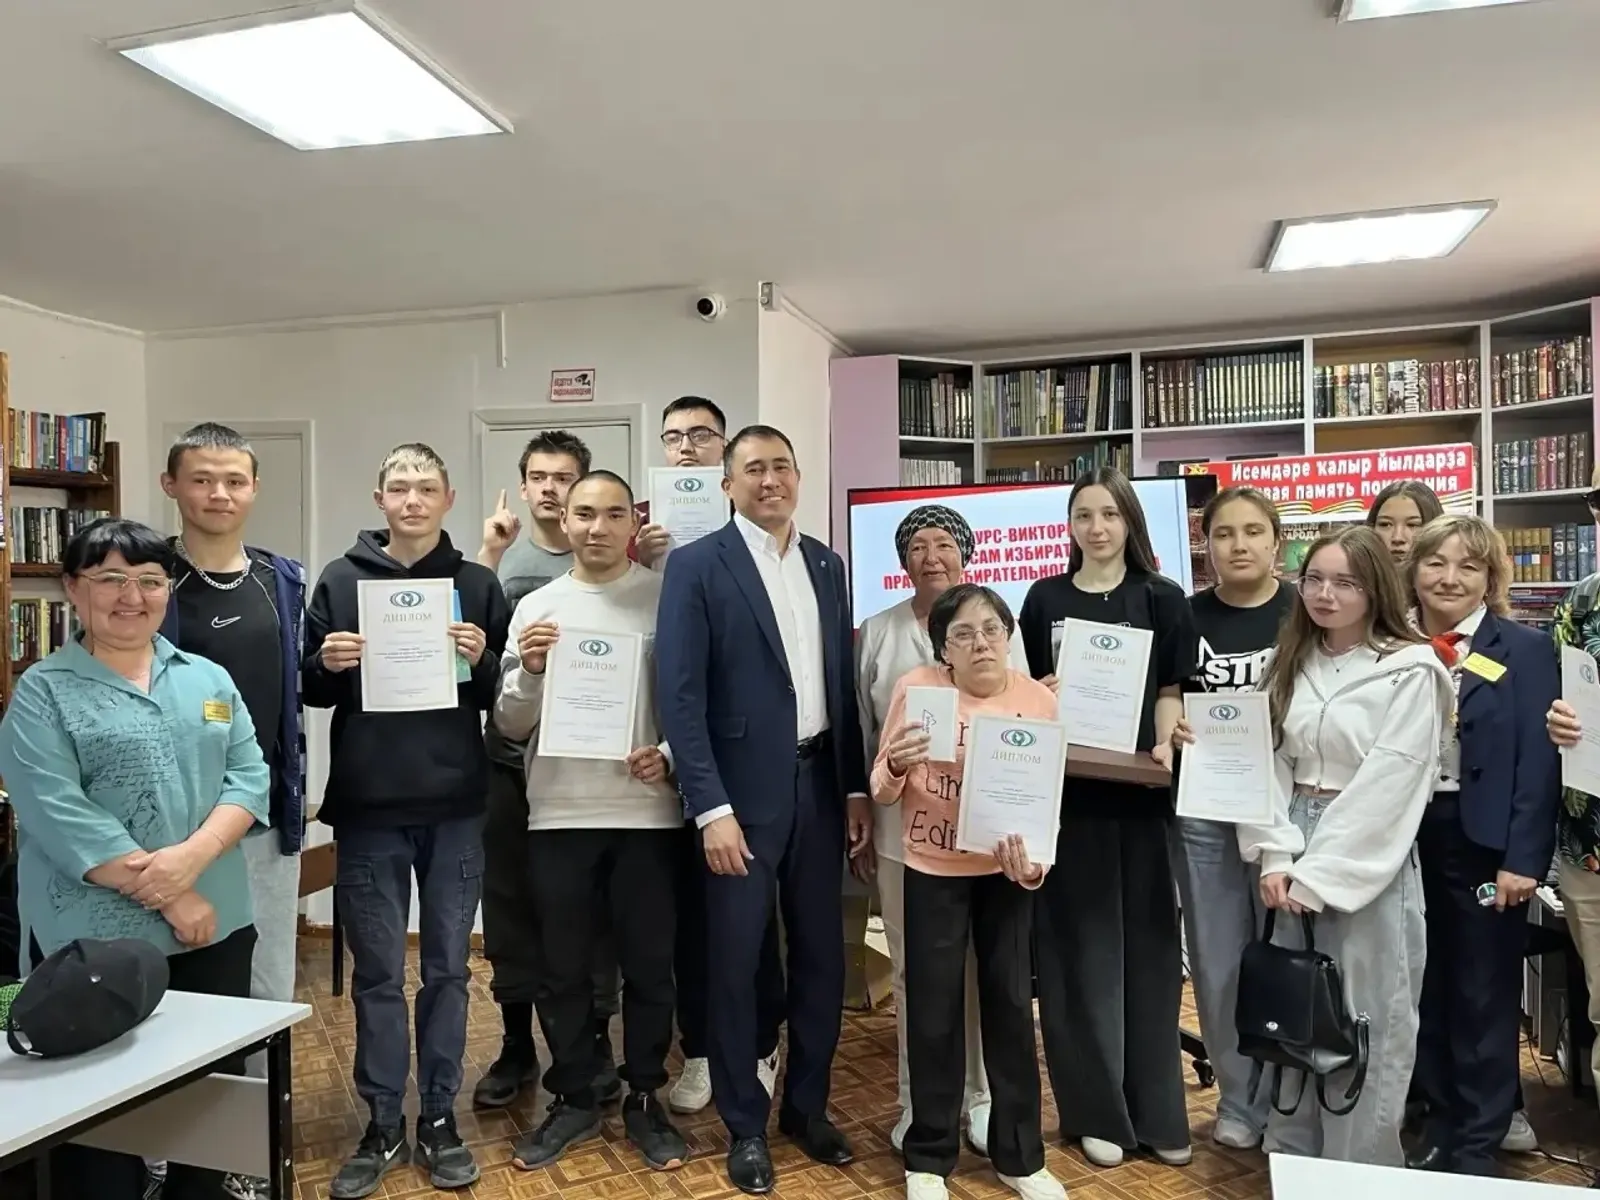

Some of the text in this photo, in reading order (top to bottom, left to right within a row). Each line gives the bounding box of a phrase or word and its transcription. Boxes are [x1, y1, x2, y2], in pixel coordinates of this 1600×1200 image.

[1403, 358, 1419, 414] ШАЛАМОВ
[1231, 462, 1311, 482] Исемдәре
[1295, 481, 1355, 500] память
[974, 523, 1071, 545] УРС-ВИКТОР
[970, 543, 1071, 565] САМ ИЗБИРАТ
[884, 563, 1067, 590] ПРА БИРАТЕЛЬНОГ
[383, 612, 432, 623] ДИПЛОМ
[569, 660, 618, 672] ДИПЛОМ
[1081, 651, 1126, 666] ДИПЛОМ
[991, 751, 1041, 764] ДИПЛОМ
